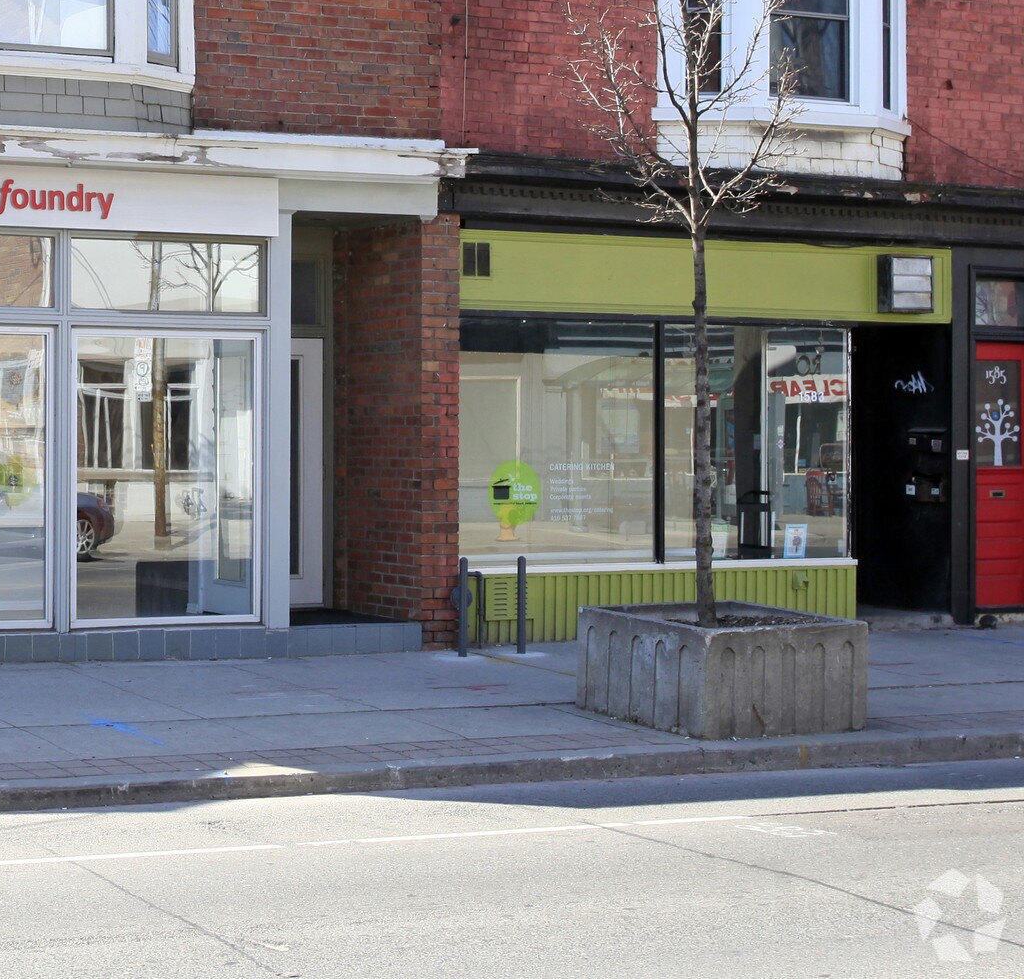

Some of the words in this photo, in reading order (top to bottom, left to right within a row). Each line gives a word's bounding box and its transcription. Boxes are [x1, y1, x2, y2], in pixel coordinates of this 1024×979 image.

[985, 366, 1007, 384] 1585
[799, 391, 825, 402] 1583
[549, 463, 583, 471] CATERING
[585, 462, 615, 471] KITCHEN
[513, 483, 533, 492] the
[512, 492, 538, 502] stop
